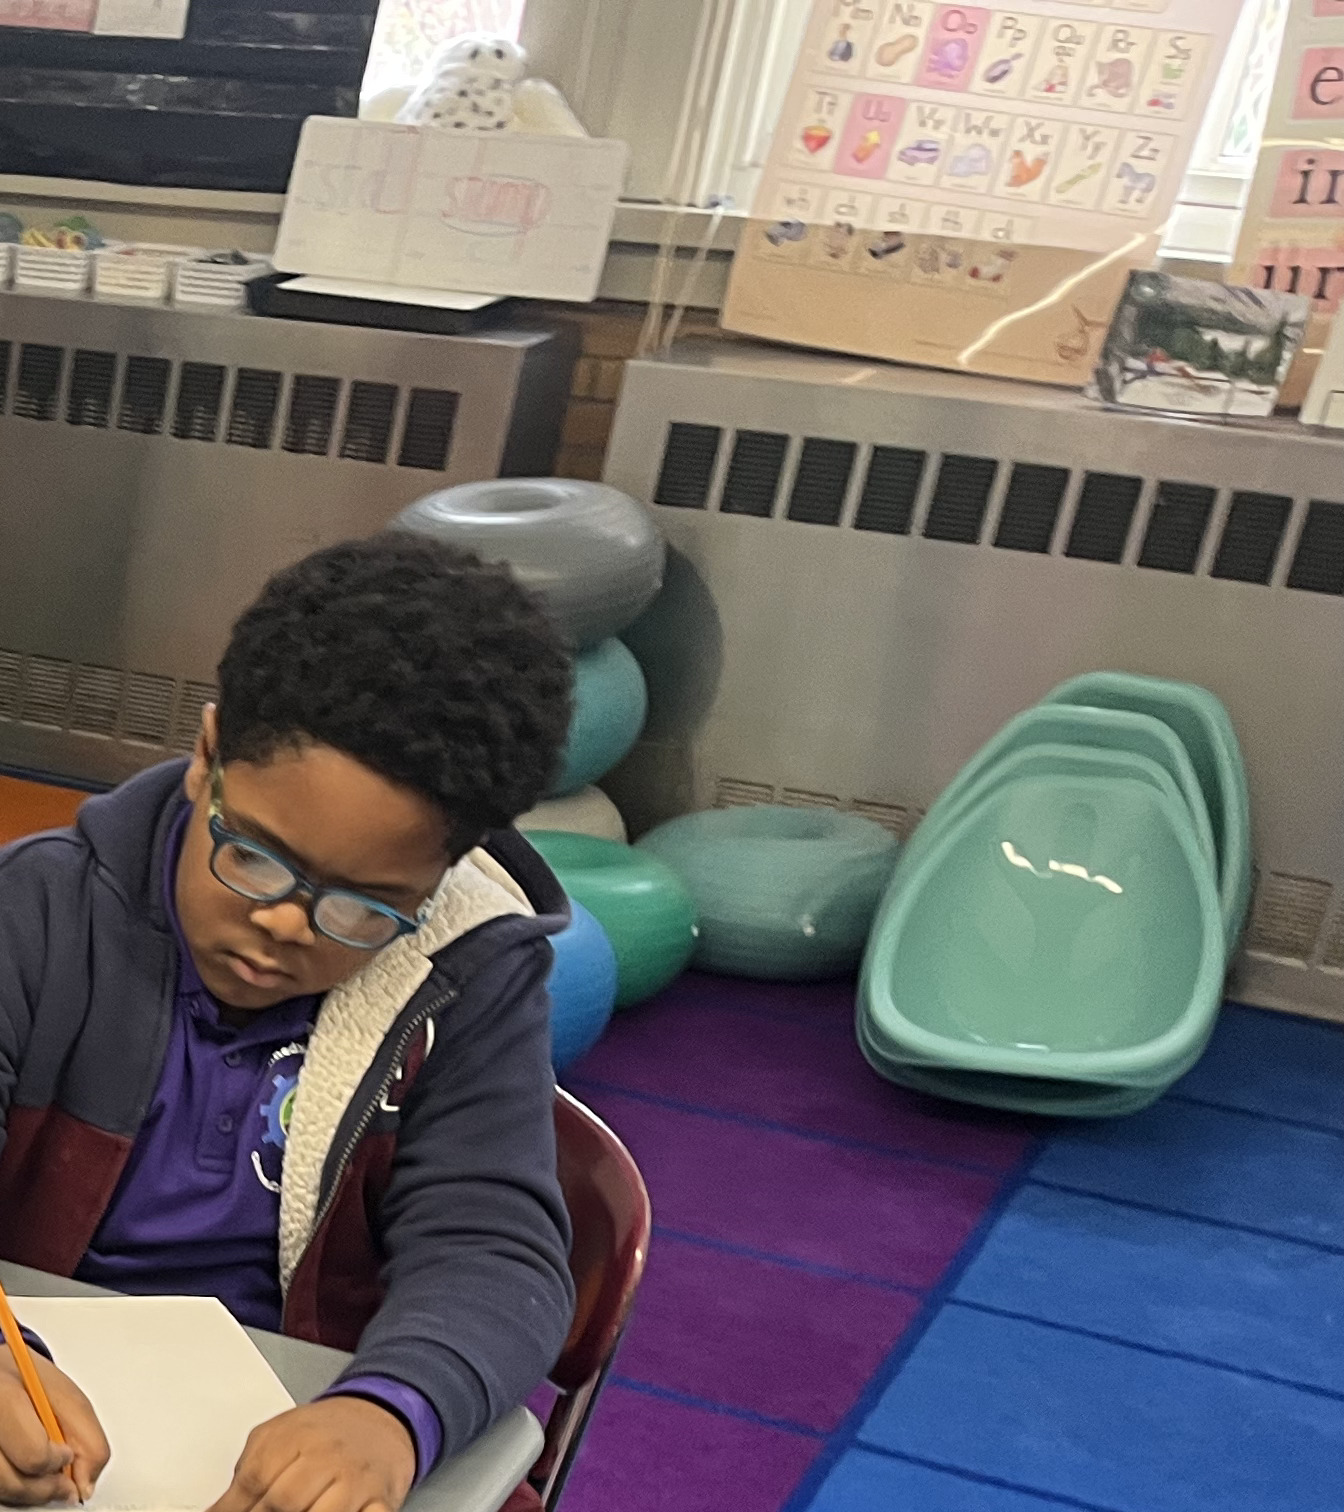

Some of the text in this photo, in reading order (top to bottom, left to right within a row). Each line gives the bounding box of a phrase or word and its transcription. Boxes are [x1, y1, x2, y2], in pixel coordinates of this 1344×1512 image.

[942, 9, 978, 35] Oo
[995, 16, 1028, 49] Pp
[1021, 120, 1054, 148] Xx
[1078, 127, 1107, 161] Yy
[1129, 134, 1162, 162] Zz
